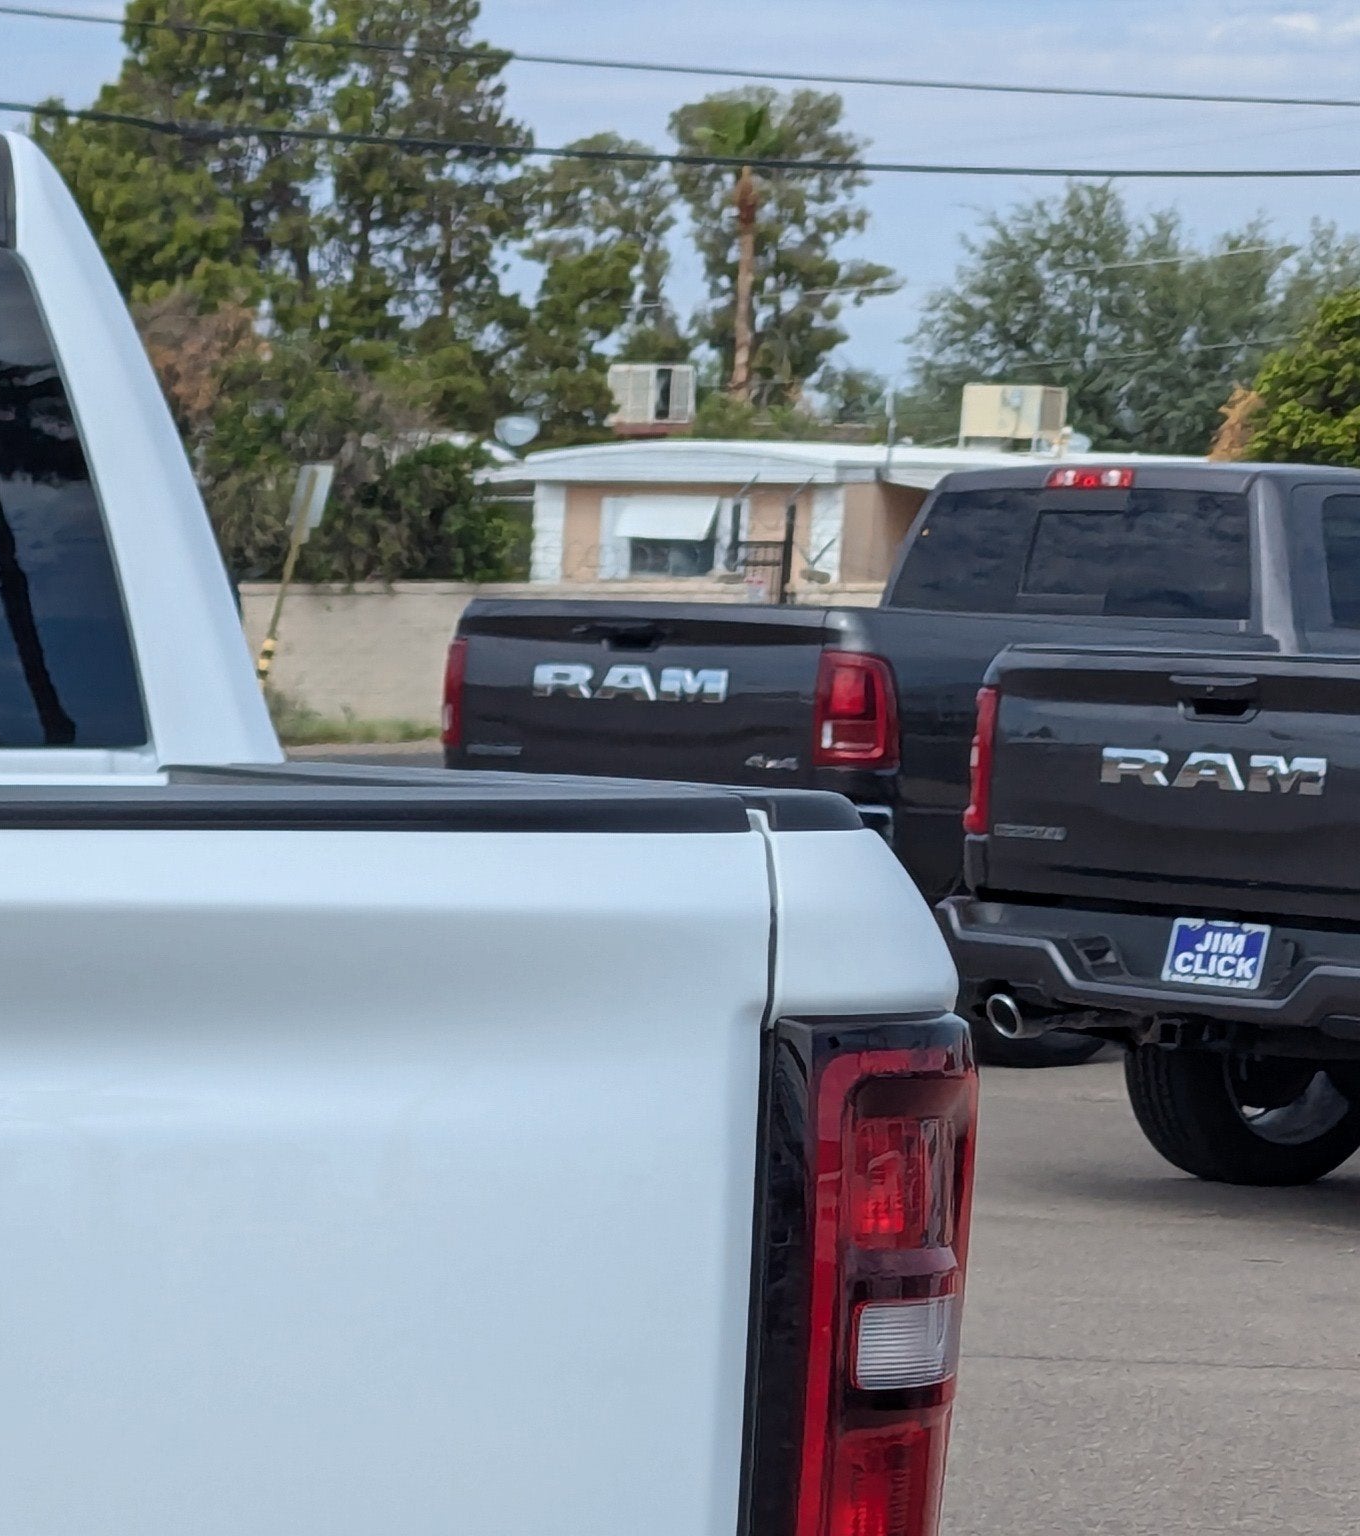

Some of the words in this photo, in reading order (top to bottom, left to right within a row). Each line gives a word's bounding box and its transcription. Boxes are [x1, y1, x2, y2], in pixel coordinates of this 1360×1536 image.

[532, 663, 729, 703] RAM
[1099, 746, 1327, 796] RAM
[1194, 931, 1247, 955] JIM
[1174, 951, 1257, 979] CLICK
